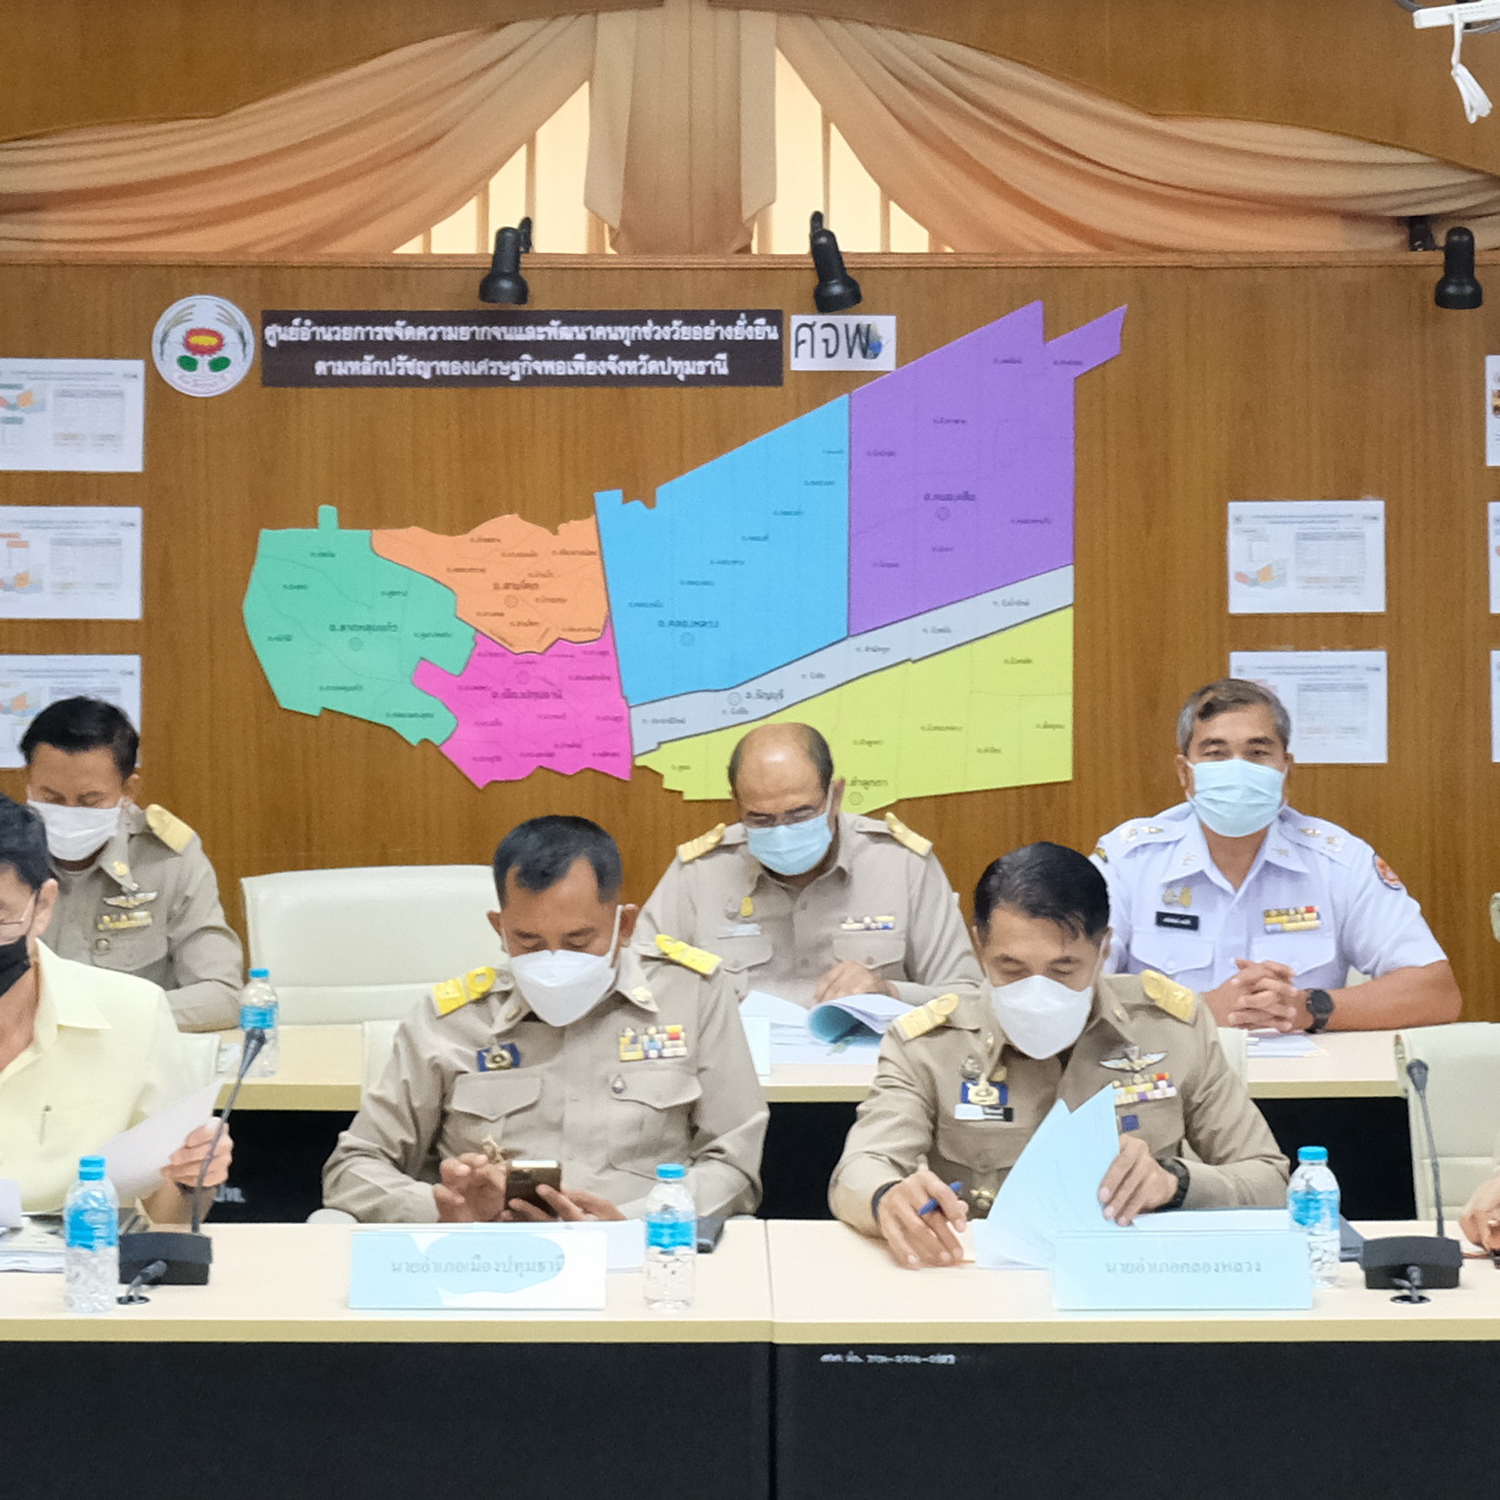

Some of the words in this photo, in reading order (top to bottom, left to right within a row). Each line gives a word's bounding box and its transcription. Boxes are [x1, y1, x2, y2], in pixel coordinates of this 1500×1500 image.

[314, 353, 729, 381] ตามหลักปรัชญาของเศรษฐกิจพอเพียงจังหวัดปทุมธานี
